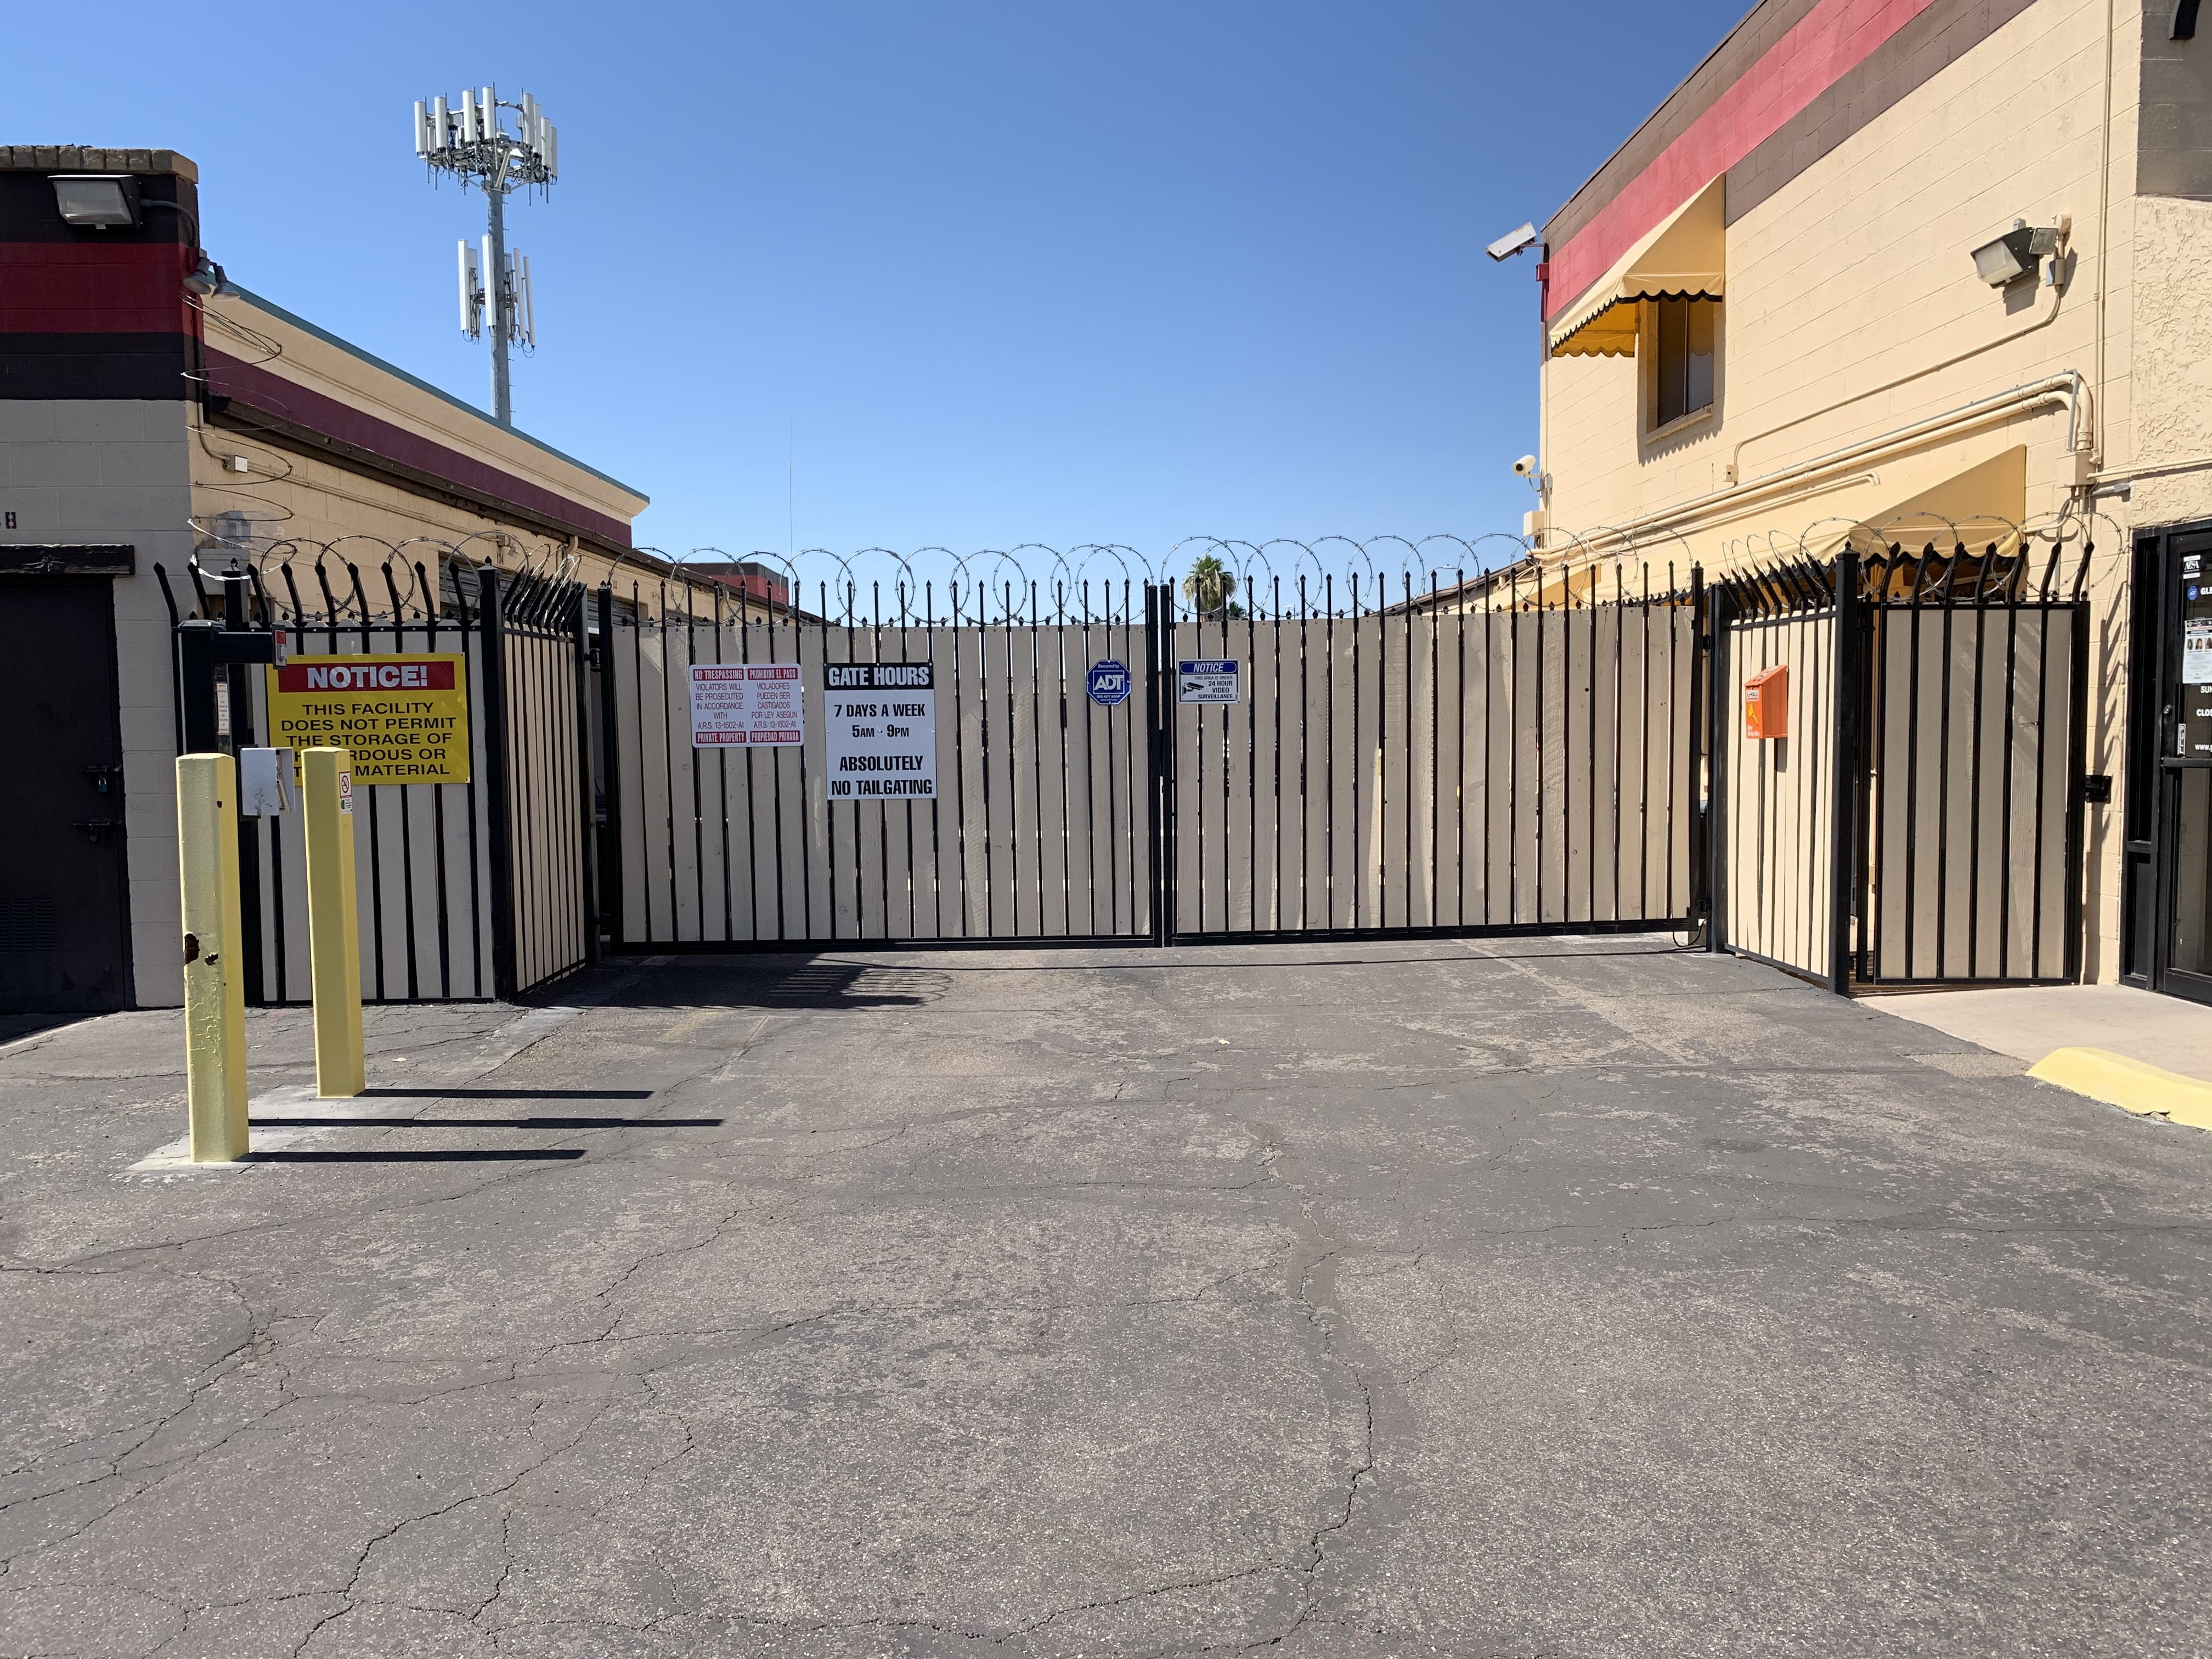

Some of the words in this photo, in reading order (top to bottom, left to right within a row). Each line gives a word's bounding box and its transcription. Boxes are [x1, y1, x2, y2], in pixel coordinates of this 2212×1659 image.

[695, 670, 702, 680] NO
[704, 669, 742, 680] TRESPASSING
[750, 669, 774, 679] PROHIBIDO
[776, 669, 782, 679] EL
[783, 669, 795, 679] PASO
[1193, 663, 1224, 673] NOTICE
[307, 665, 427, 689] NOTICE!
[828, 667, 868, 686] GATE
[873, 667, 929, 685] HOURS
[1094, 674, 1124, 690] ADT
[302, 704, 345, 715] THIS
[352, 702, 434, 714] FACILITY
[834, 704, 842, 717] 7
[847, 704, 877, 717] DAYS
[881, 704, 889, 716] A
[893, 703, 926, 716] WEEK
[281, 719, 334, 731] DOES
[341, 719, 379, 730] NOT
[386, 717, 457, 729] PERMIT
[852, 725, 874, 737] 5AM
[887, 724, 909, 737] 9PM
[286, 735, 323, 746] THE
[330, 733, 420, 746] STORAGE
[427, 732, 453, 744] OF
[697, 733, 718, 742] PRIVATE
[719, 732, 744, 742] PROPERTY
[751, 732, 777, 742] PROPIEDAD
[779, 731, 799, 741] PRIVADA
[295, 749, 412, 762] HRDOUS
[419, 748, 446, 760] OR
[839, 755, 923, 771] ABSOLUTELY
[355, 764, 450, 777] MATERIAL
[832, 780, 850, 795] NO
[856, 780, 932, 795] TAILGATING
